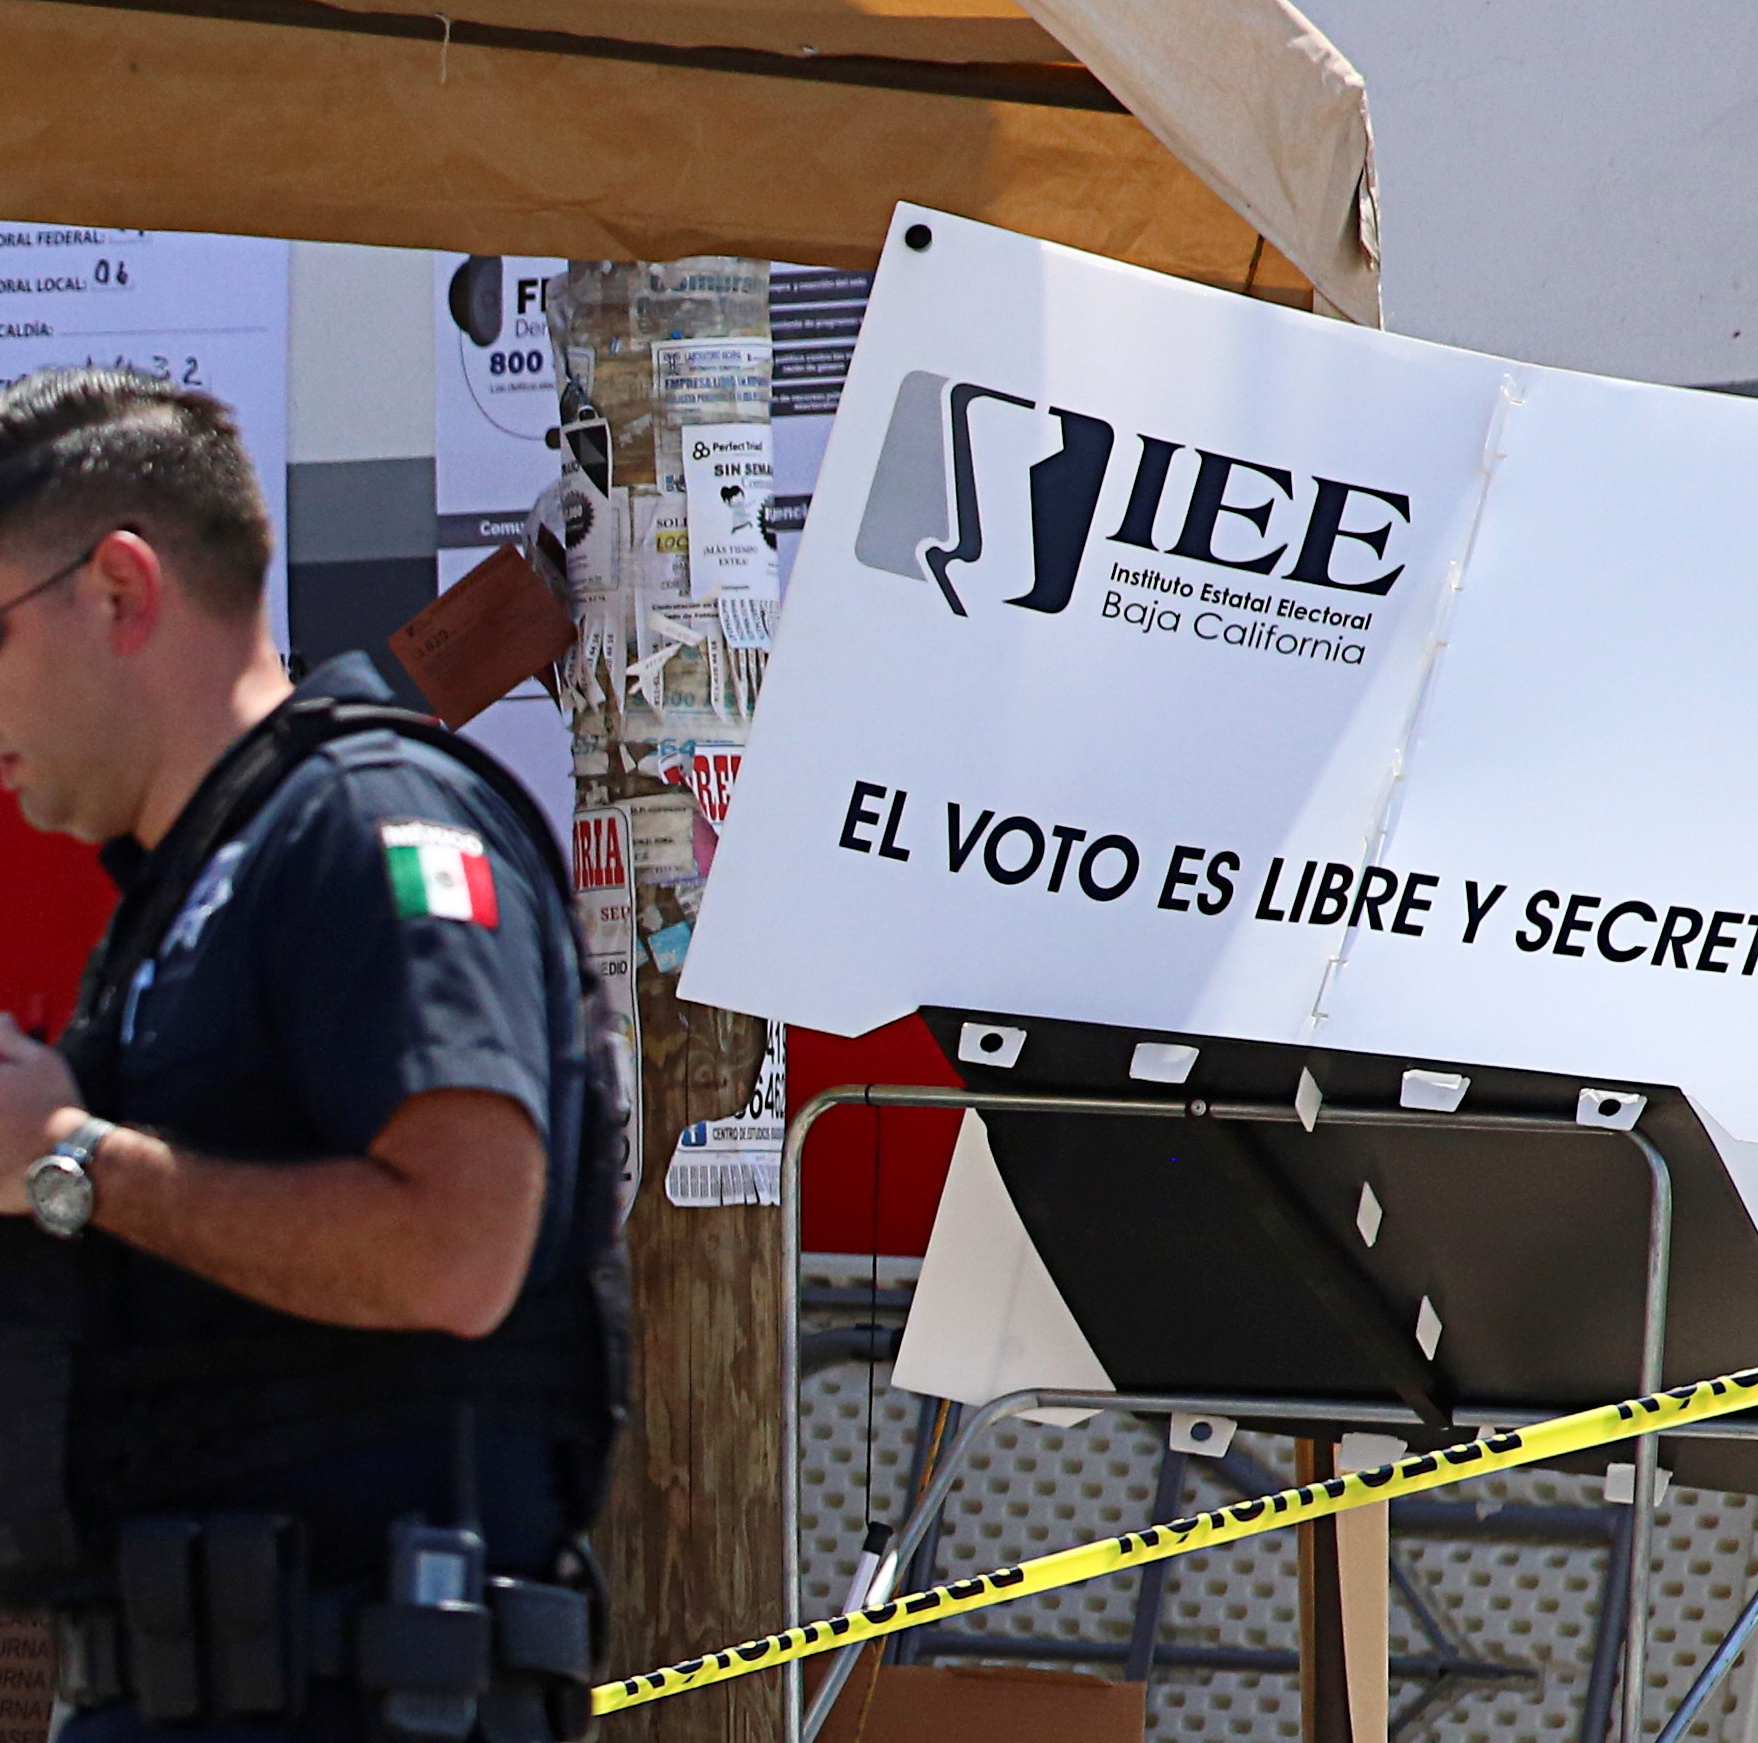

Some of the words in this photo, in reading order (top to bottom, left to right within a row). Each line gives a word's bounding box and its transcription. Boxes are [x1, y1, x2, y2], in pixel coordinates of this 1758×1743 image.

[36, 229, 105, 246] FEDERAL:
[36, 276, 86, 291] LOCAL:
[490, 350, 543, 375] 800
[713, 441, 745, 452] Perfect
[714, 463, 743, 477] SIN
[1105, 433, 1411, 597] IEE
[1110, 562, 1194, 598] Instituto
[1199, 582, 1272, 614] Estatal
[1276, 598, 1373, 631] Electoral
[1101, 590, 1181, 634] Baja
[1193, 612, 1366, 665] California
[838, 779, 911, 863] EL
[946, 801, 1141, 902] VOTO
[1157, 844, 1242, 917] ES
[1254, 857, 1441, 938] LIBRE
[1461, 879, 1509, 945] Y
[712, 1127, 738, 1140] CENTRO
